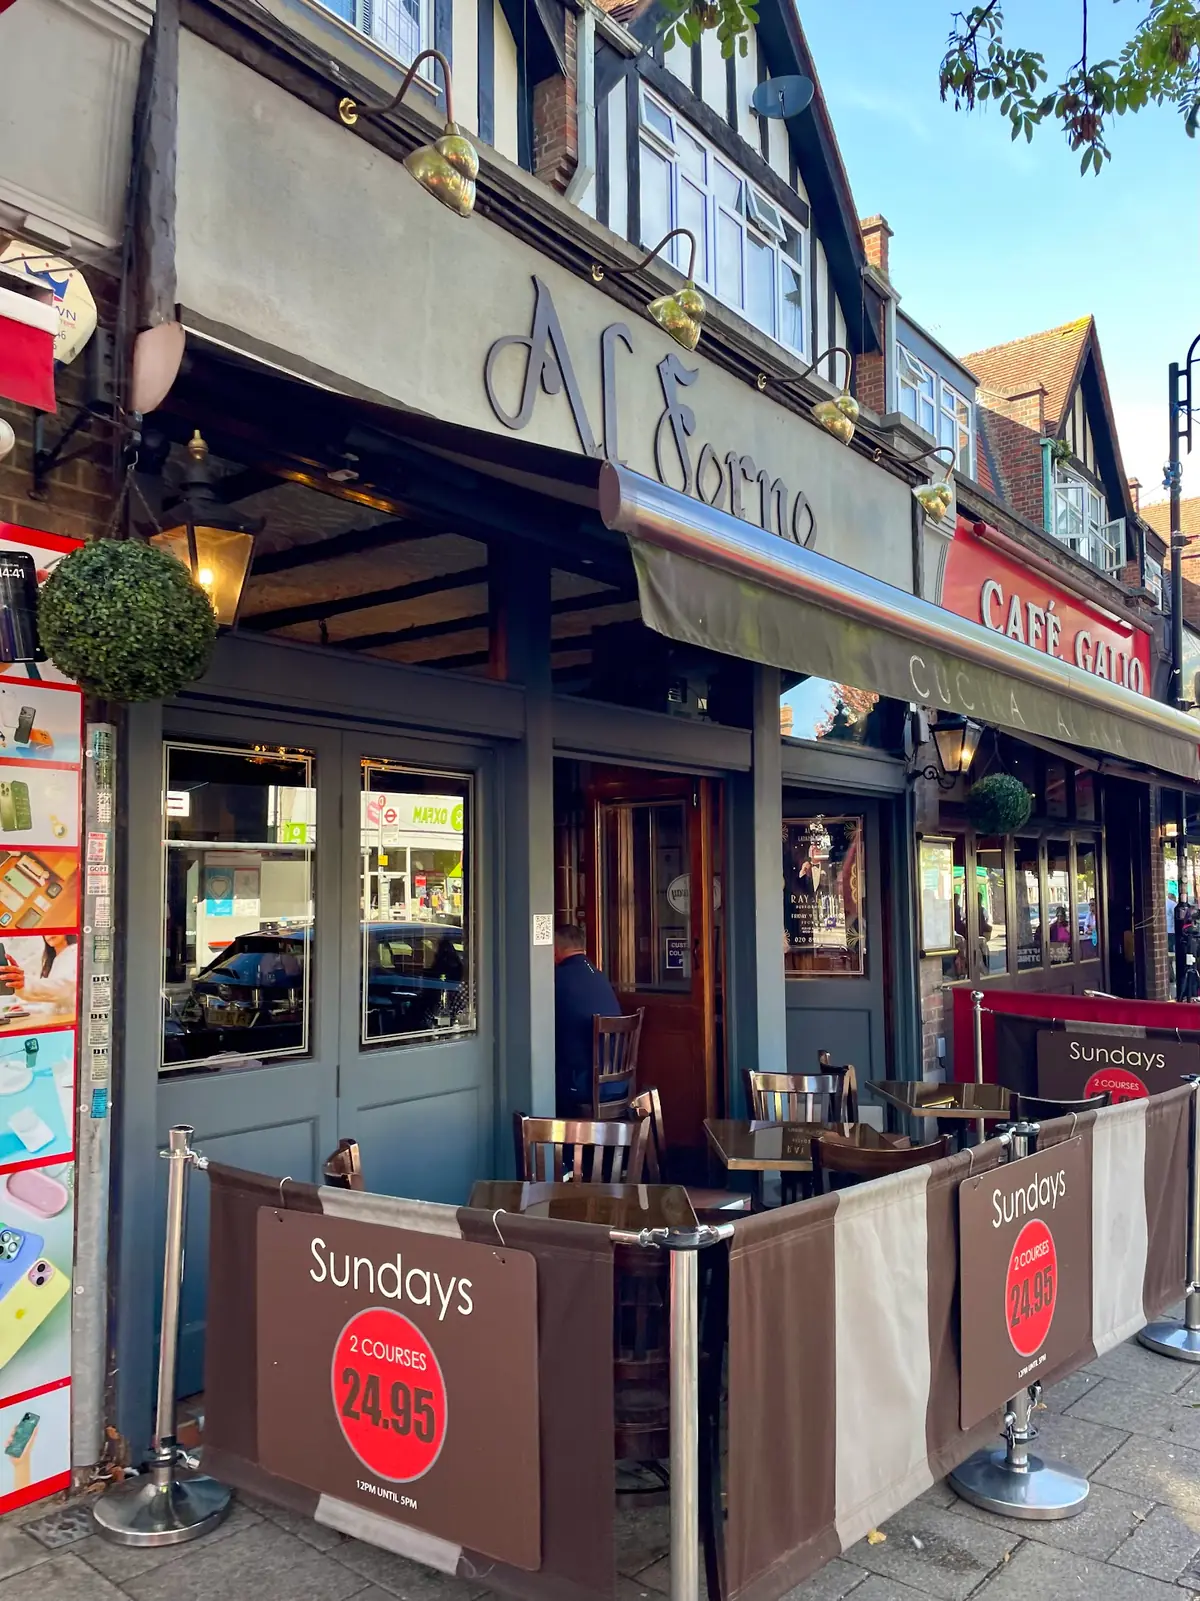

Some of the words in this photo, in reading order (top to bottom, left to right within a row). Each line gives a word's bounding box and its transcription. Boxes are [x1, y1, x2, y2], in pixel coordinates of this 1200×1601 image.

[484, 274, 633, 465] Al
[654, 353, 817, 551] Forno
[1069, 1040, 1166, 1072] Sundays
[1094, 1079, 1099, 1087] 2
[1101, 1079, 1140, 1091] COURSES
[992, 1169, 1067, 1229] Sundays
[309, 1237, 474, 1321] Sundays
[1014, 1256, 1020, 1271] 2
[1020, 1239, 1050, 1267] COURSES
[1010, 1264, 1053, 1329] 24.95
[349, 1335, 359, 1354] 2
[361, 1338, 427, 1372] COURSES
[341, 1367, 436, 1444] 24.95
[355, 1479, 377, 1496] 12PM
[377, 1485, 399, 1503] UNTIL
[400, 1495, 418, 1510] 5PM
